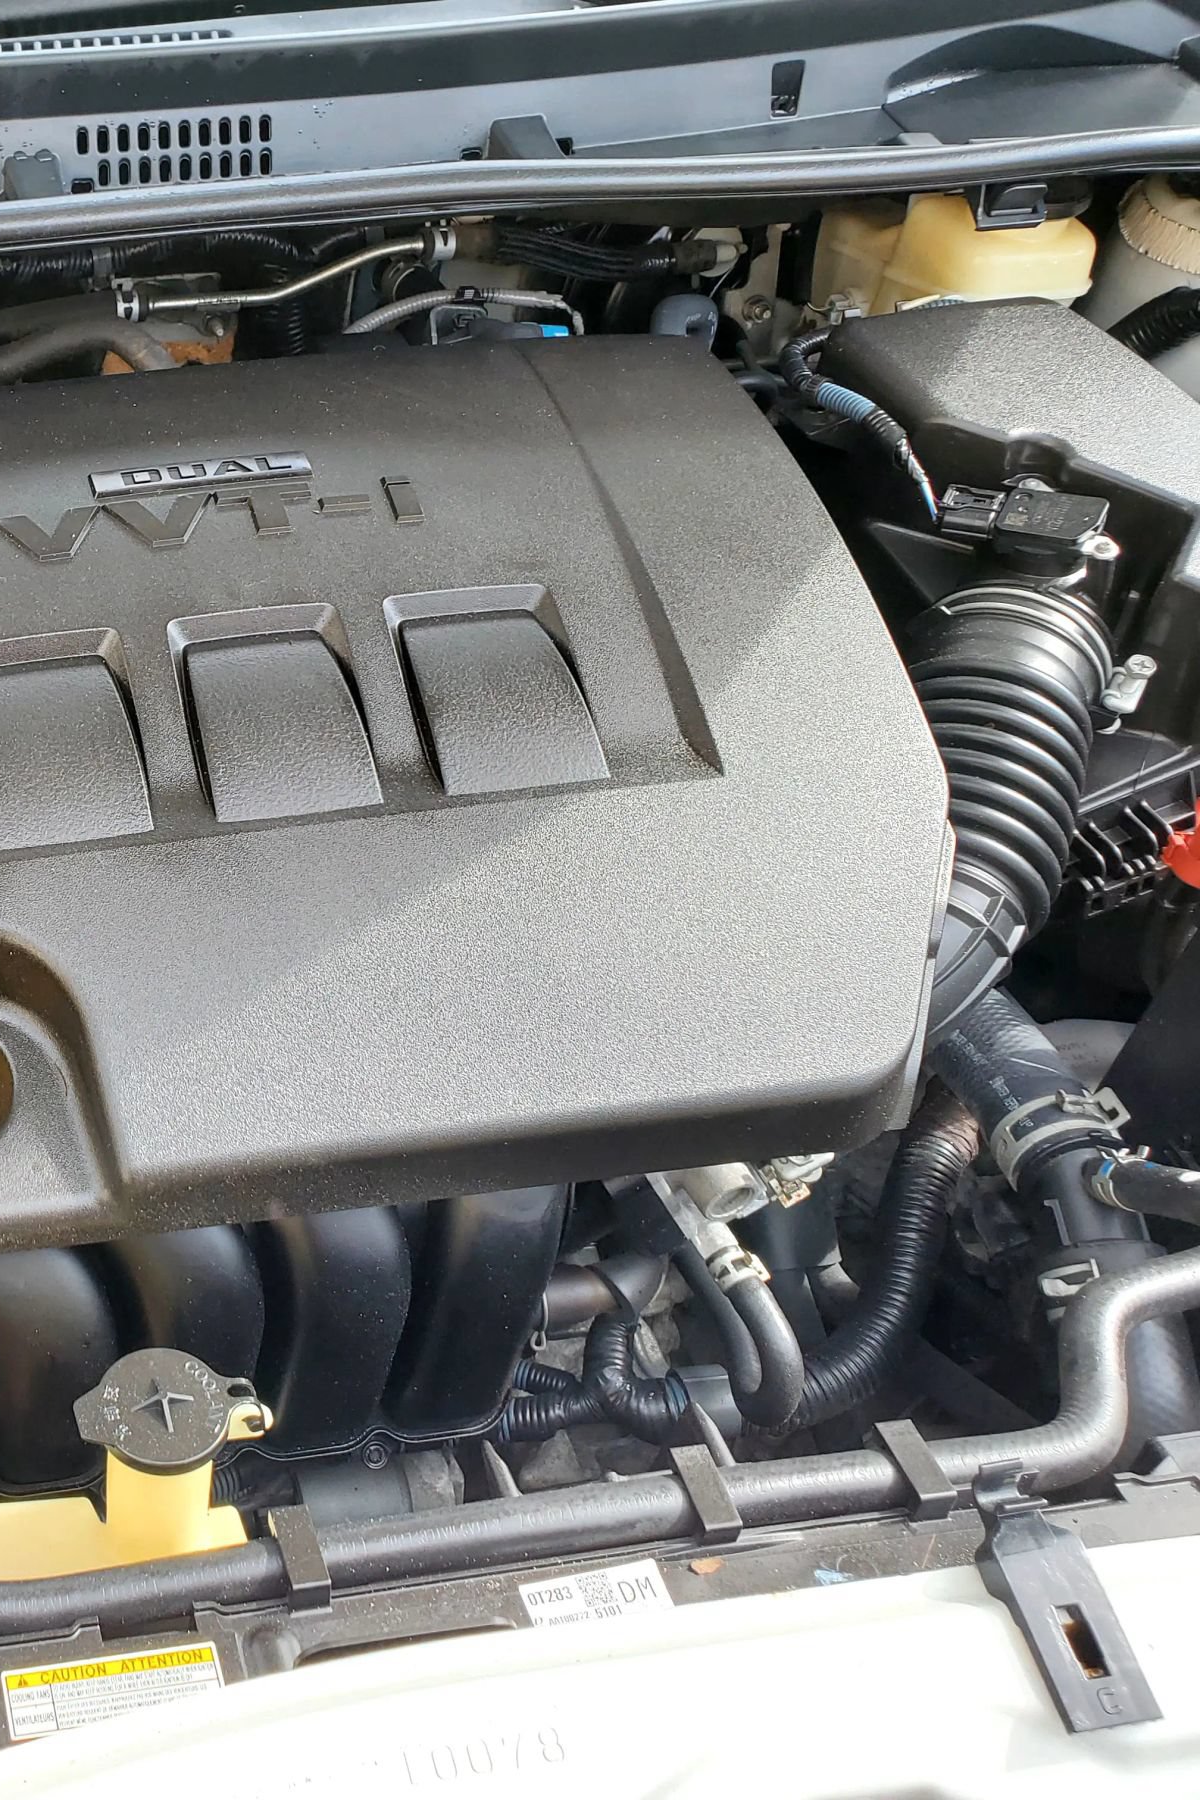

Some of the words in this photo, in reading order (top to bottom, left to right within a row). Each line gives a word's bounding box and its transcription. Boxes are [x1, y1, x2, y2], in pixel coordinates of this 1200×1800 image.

[121, 457, 293, 486] DUAL
[617, 1576, 657, 1604] DM
[40, 1663, 107, 1684] CAUTION
[120, 1649, 203, 1672] ATTENTION
[11, 1690, 36, 1703] COOLING
[36, 1688, 51, 1701] FANS
[15, 1712, 55, 1727] VENTILATEURS
